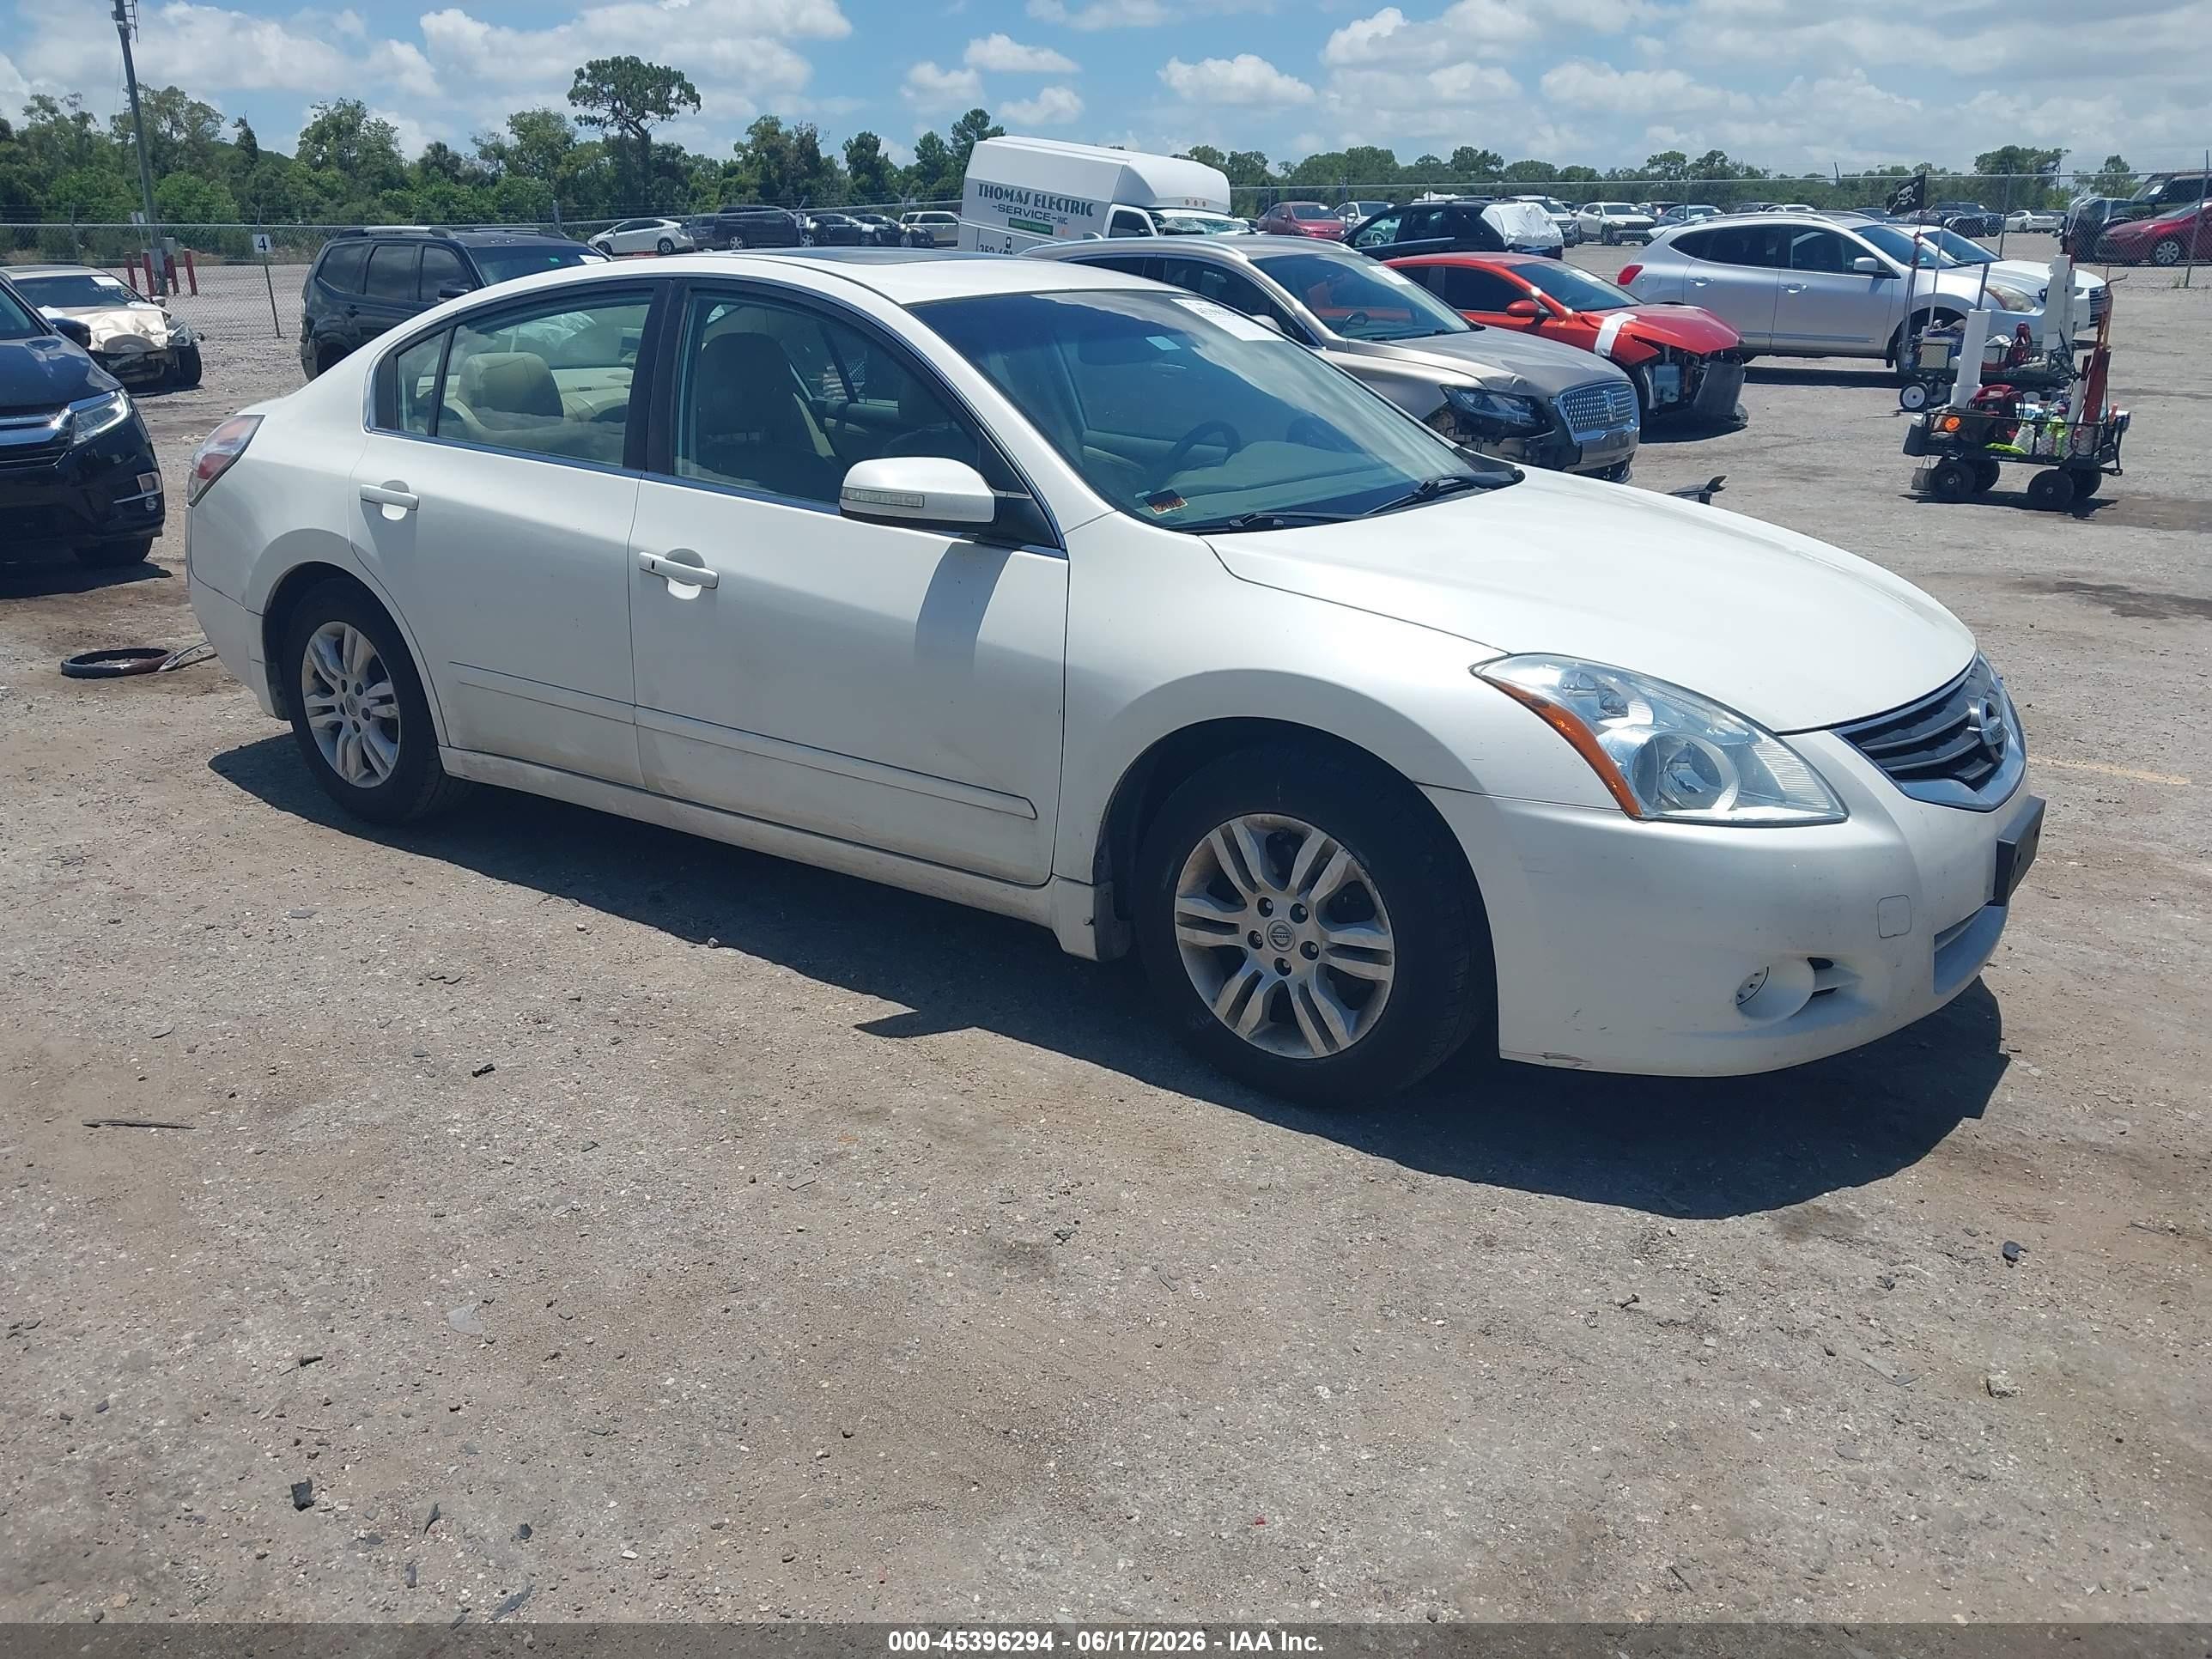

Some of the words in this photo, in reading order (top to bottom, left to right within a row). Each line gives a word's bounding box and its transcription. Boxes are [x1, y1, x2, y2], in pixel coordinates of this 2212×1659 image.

[978, 183, 1031, 205] THOMAS
[1033, 193, 1095, 217] ELECTRIC
[258, 236, 267, 251] 4
